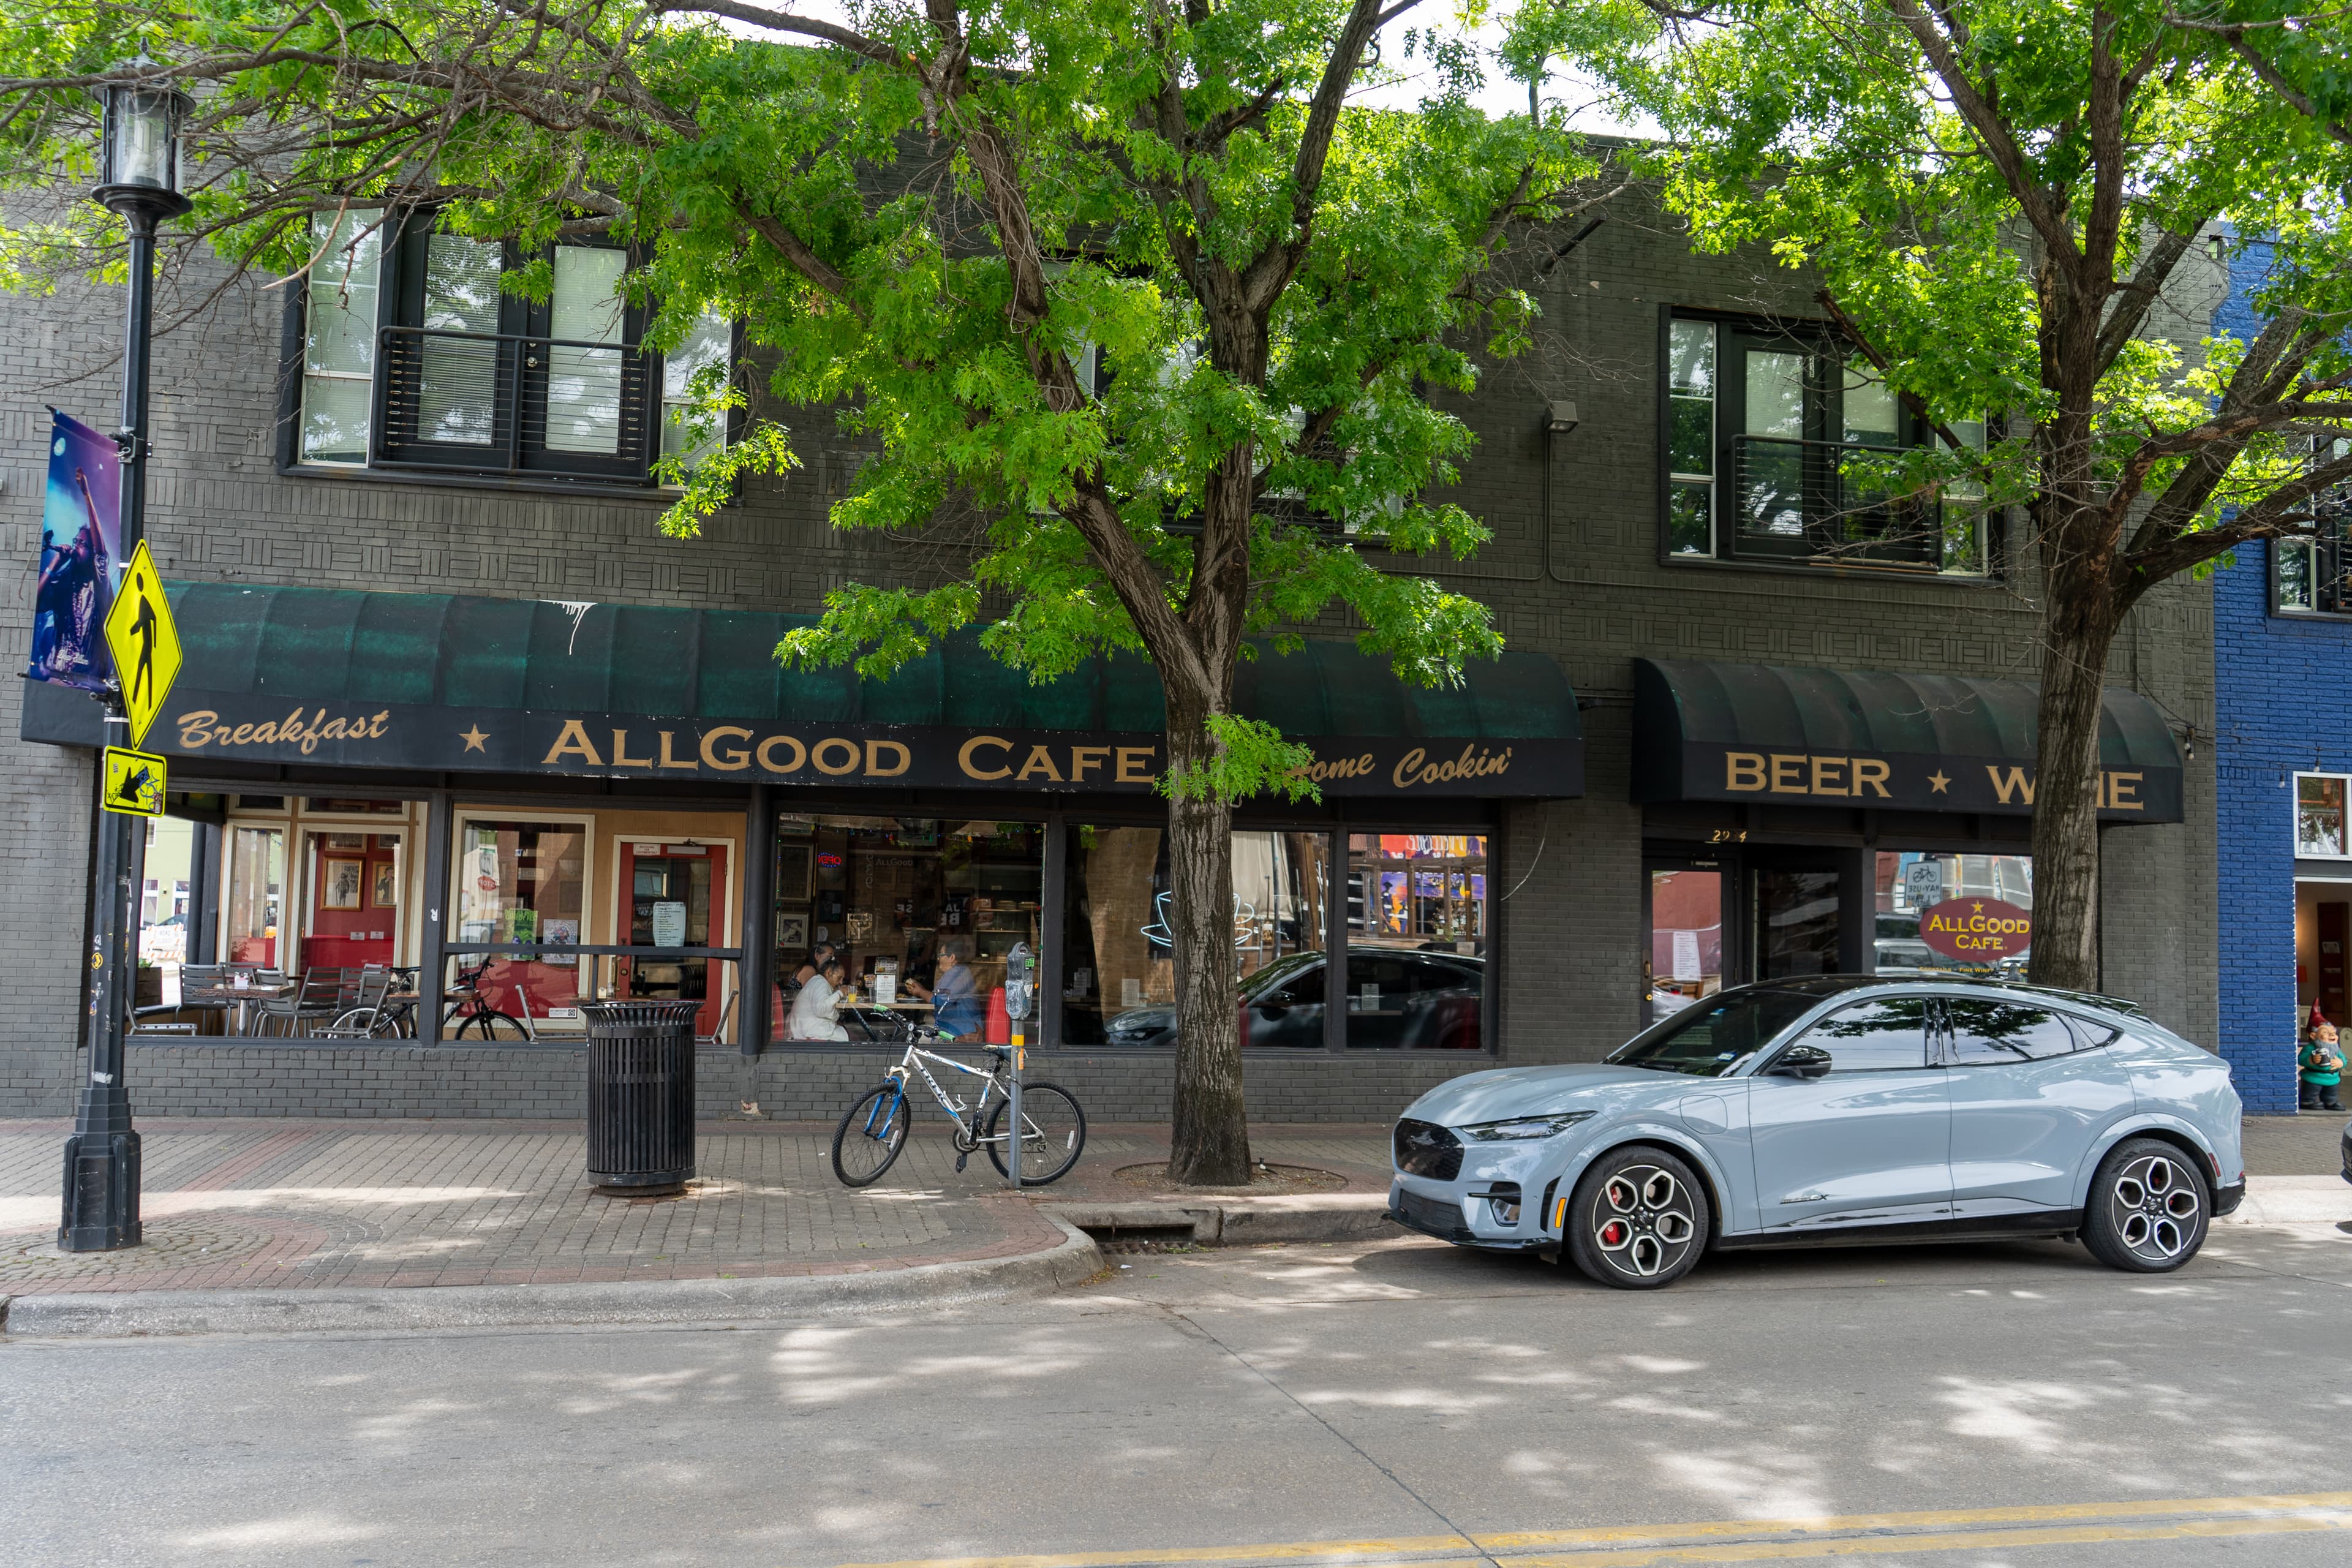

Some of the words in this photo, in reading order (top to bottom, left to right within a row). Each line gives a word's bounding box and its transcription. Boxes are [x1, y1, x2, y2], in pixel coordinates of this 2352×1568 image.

[177, 707, 389, 755] Breakfast
[541, 720, 911, 777] ALLGOOD
[958, 736, 1156, 783] CAFE
[1393, 743, 1513, 788] Cookin'
[1725, 752, 1893, 797] BEER
[1985, 765, 2144, 810] WE
[1712, 829, 1747, 843] 294
[1928, 914, 2030, 934] ALLGOOD
[1955, 934, 2003, 950] CAFE
